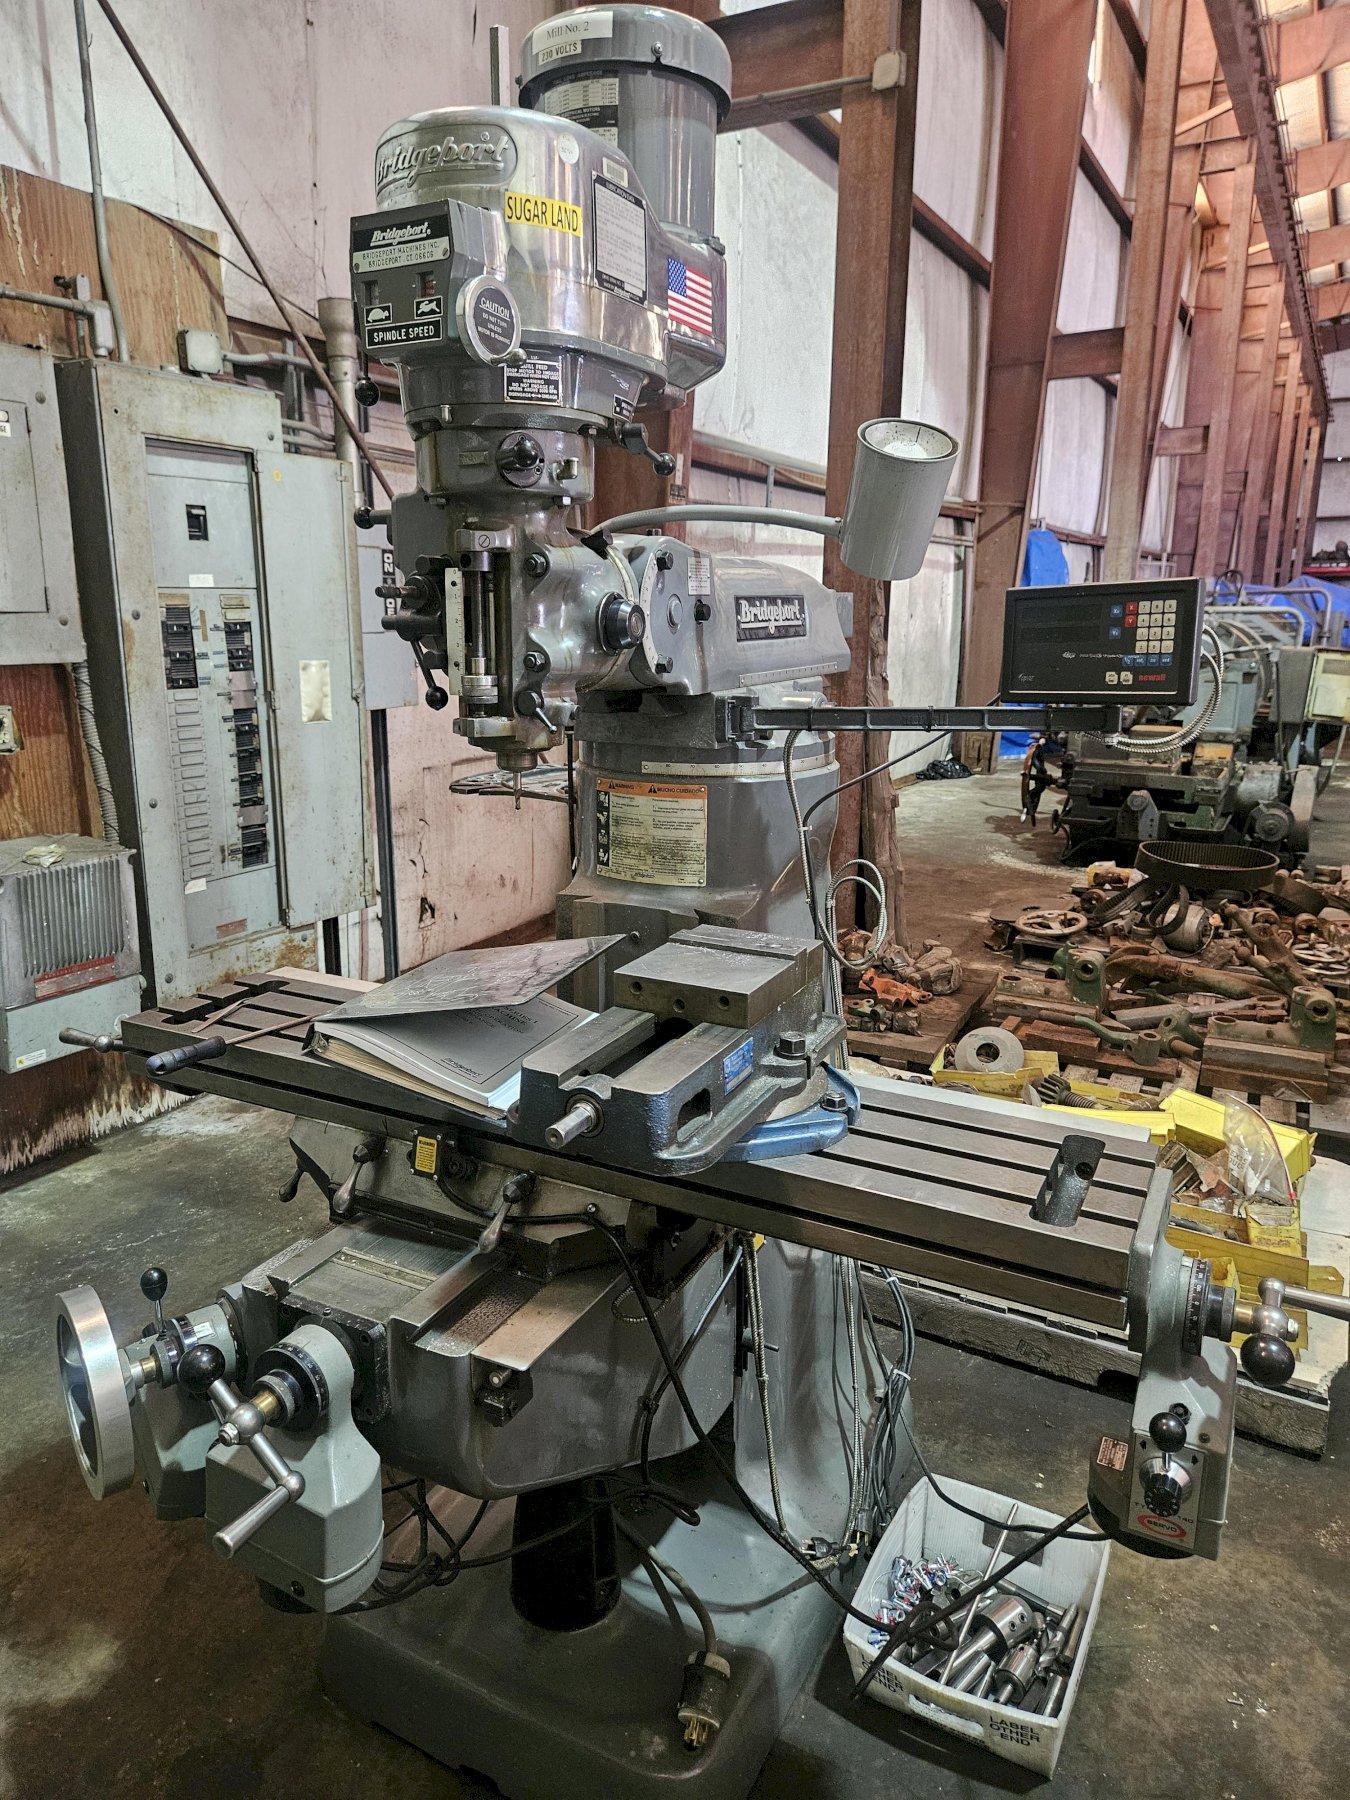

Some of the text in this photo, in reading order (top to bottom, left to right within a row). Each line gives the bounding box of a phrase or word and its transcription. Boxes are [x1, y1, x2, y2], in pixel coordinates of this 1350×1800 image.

[546, 21, 590, 40] Mill No. 2
[542, 42, 578, 62] 230 VOLTS
[377, 136, 509, 188] Bridgeport
[507, 196, 578, 232] SUGAR LAND
[372, 222, 428, 246] Bridgeport
[398, 244, 426, 254] MACHINES
[480, 297, 510, 318] CAUTION
[482, 312, 488, 320] DO
[489, 315, 497, 324] NOT
[373, 326, 435, 343] SPINDLE SPEED
[384, 552, 394, 573] ON
[739, 600, 801, 634] Bridgeport
[1147, 1519, 1178, 1532] SERVO
[990, 1716, 1040, 1735] LABEL
[990, 1724, 1040, 1742] OTHER
[1001, 1732, 1030, 1746] END
